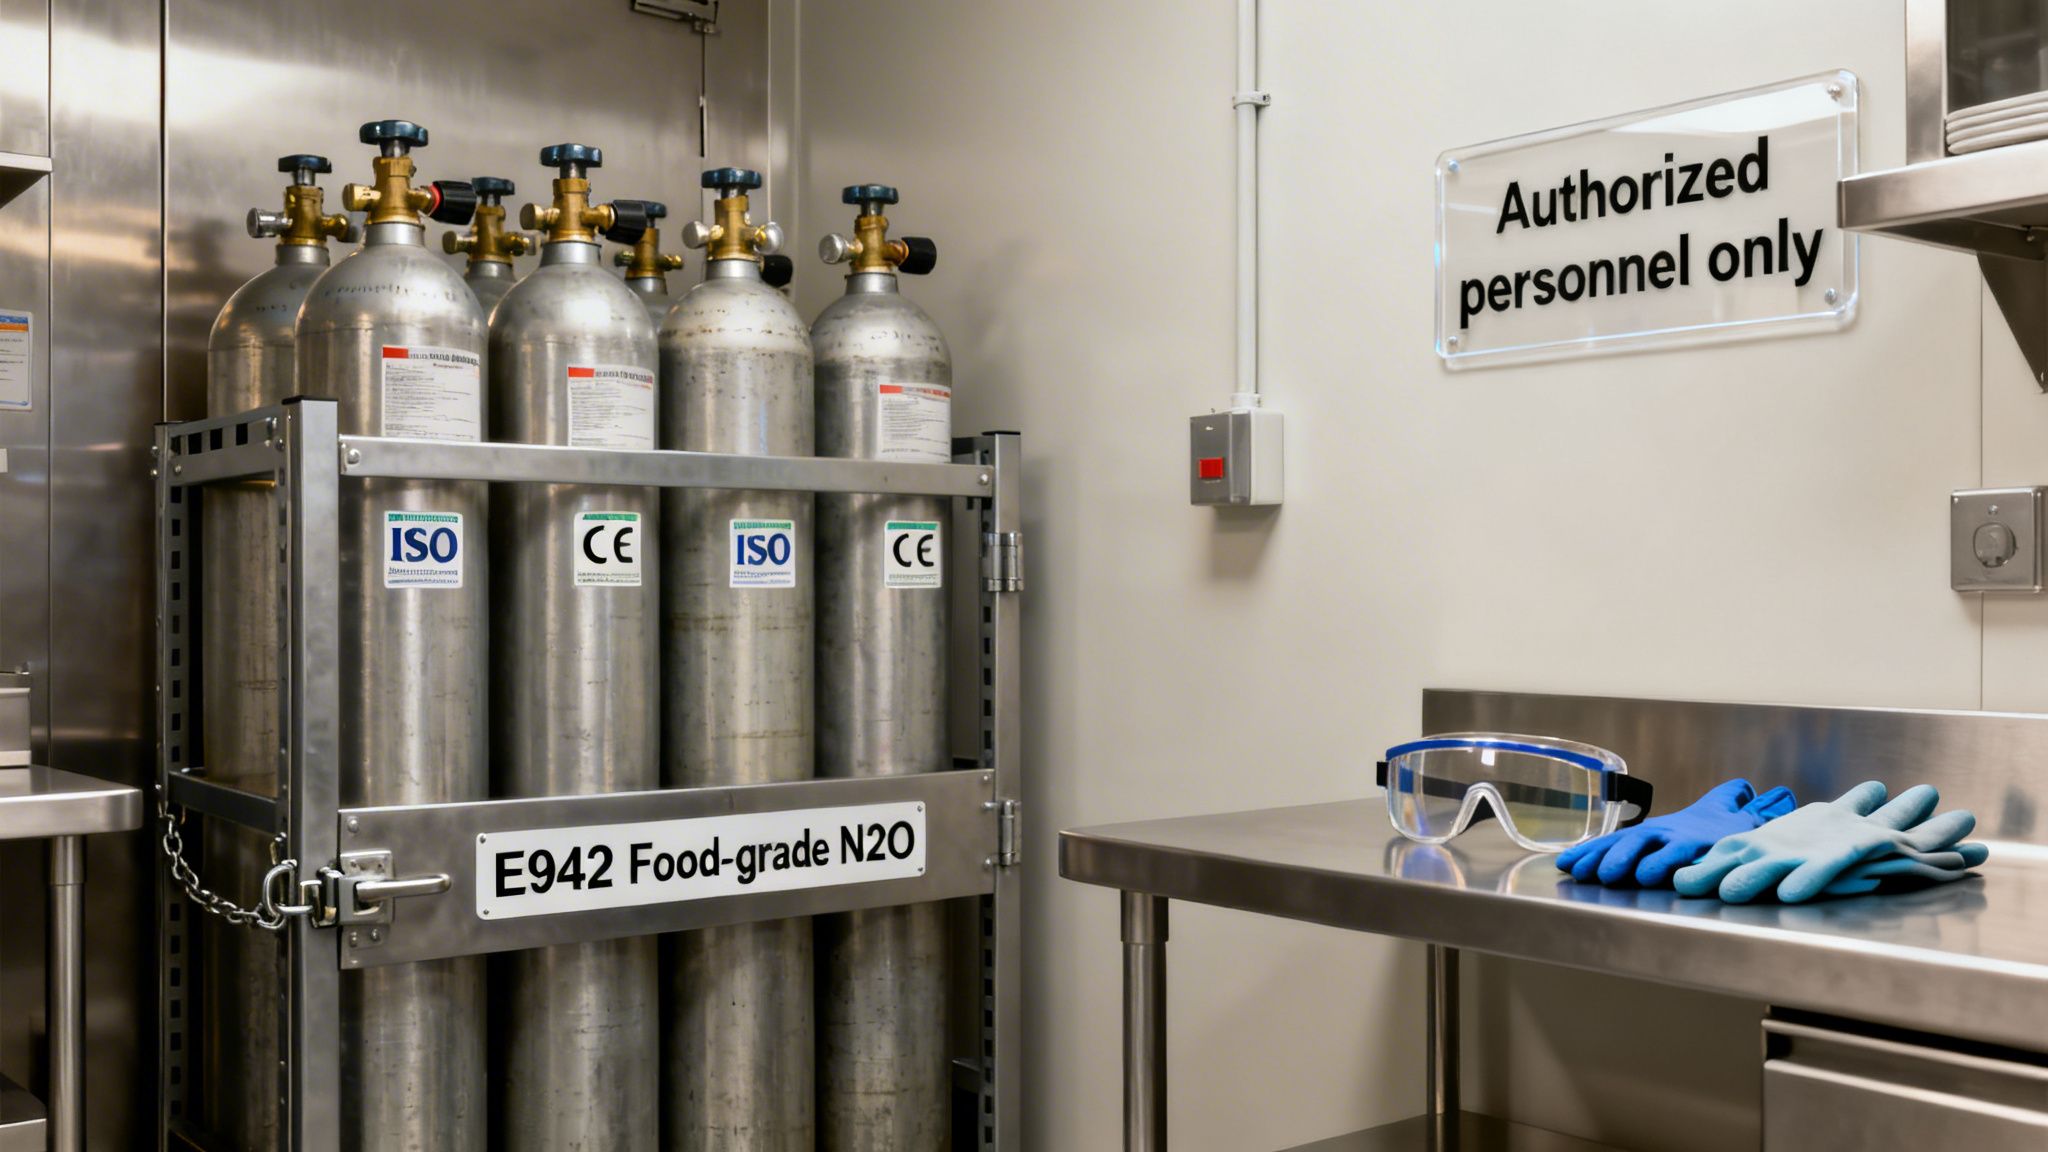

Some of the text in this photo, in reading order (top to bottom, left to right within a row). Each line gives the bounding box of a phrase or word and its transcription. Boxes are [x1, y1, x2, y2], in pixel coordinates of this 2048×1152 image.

[1496, 135, 1769, 235] Authorized
[1459, 217, 1824, 330] personnel only
[390, 527, 458, 563] ISO
[583, 525, 634, 565] CE
[736, 533, 791, 566] ISO
[892, 533, 935, 568] CE
[495, 820, 915, 898] E942 Food-grade N2O
